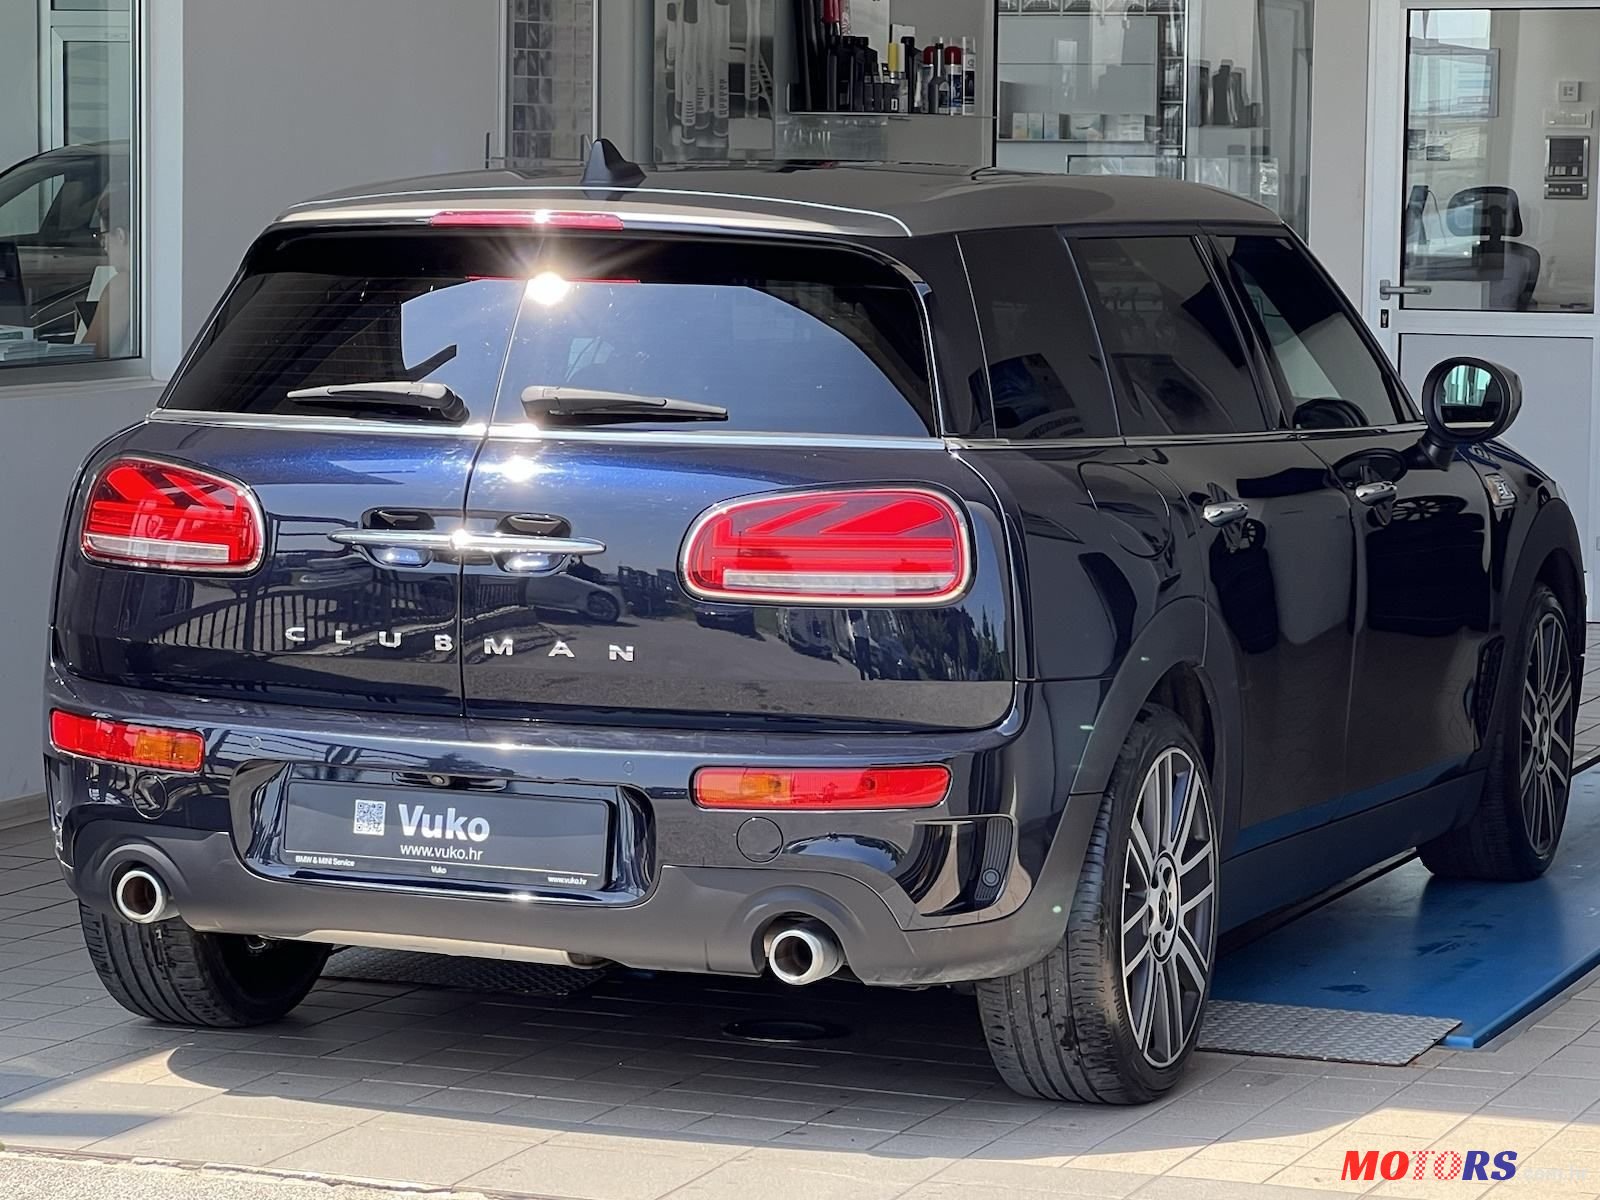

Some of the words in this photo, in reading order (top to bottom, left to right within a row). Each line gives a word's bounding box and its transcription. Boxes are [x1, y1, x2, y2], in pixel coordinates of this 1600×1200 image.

[285, 626, 635, 662] CLUBMAN
[398, 803, 490, 842] Vuko
[400, 844, 484, 860] www.vuko.hr
[333, 858, 355, 867] Service
[430, 865, 448, 874] Vuko
